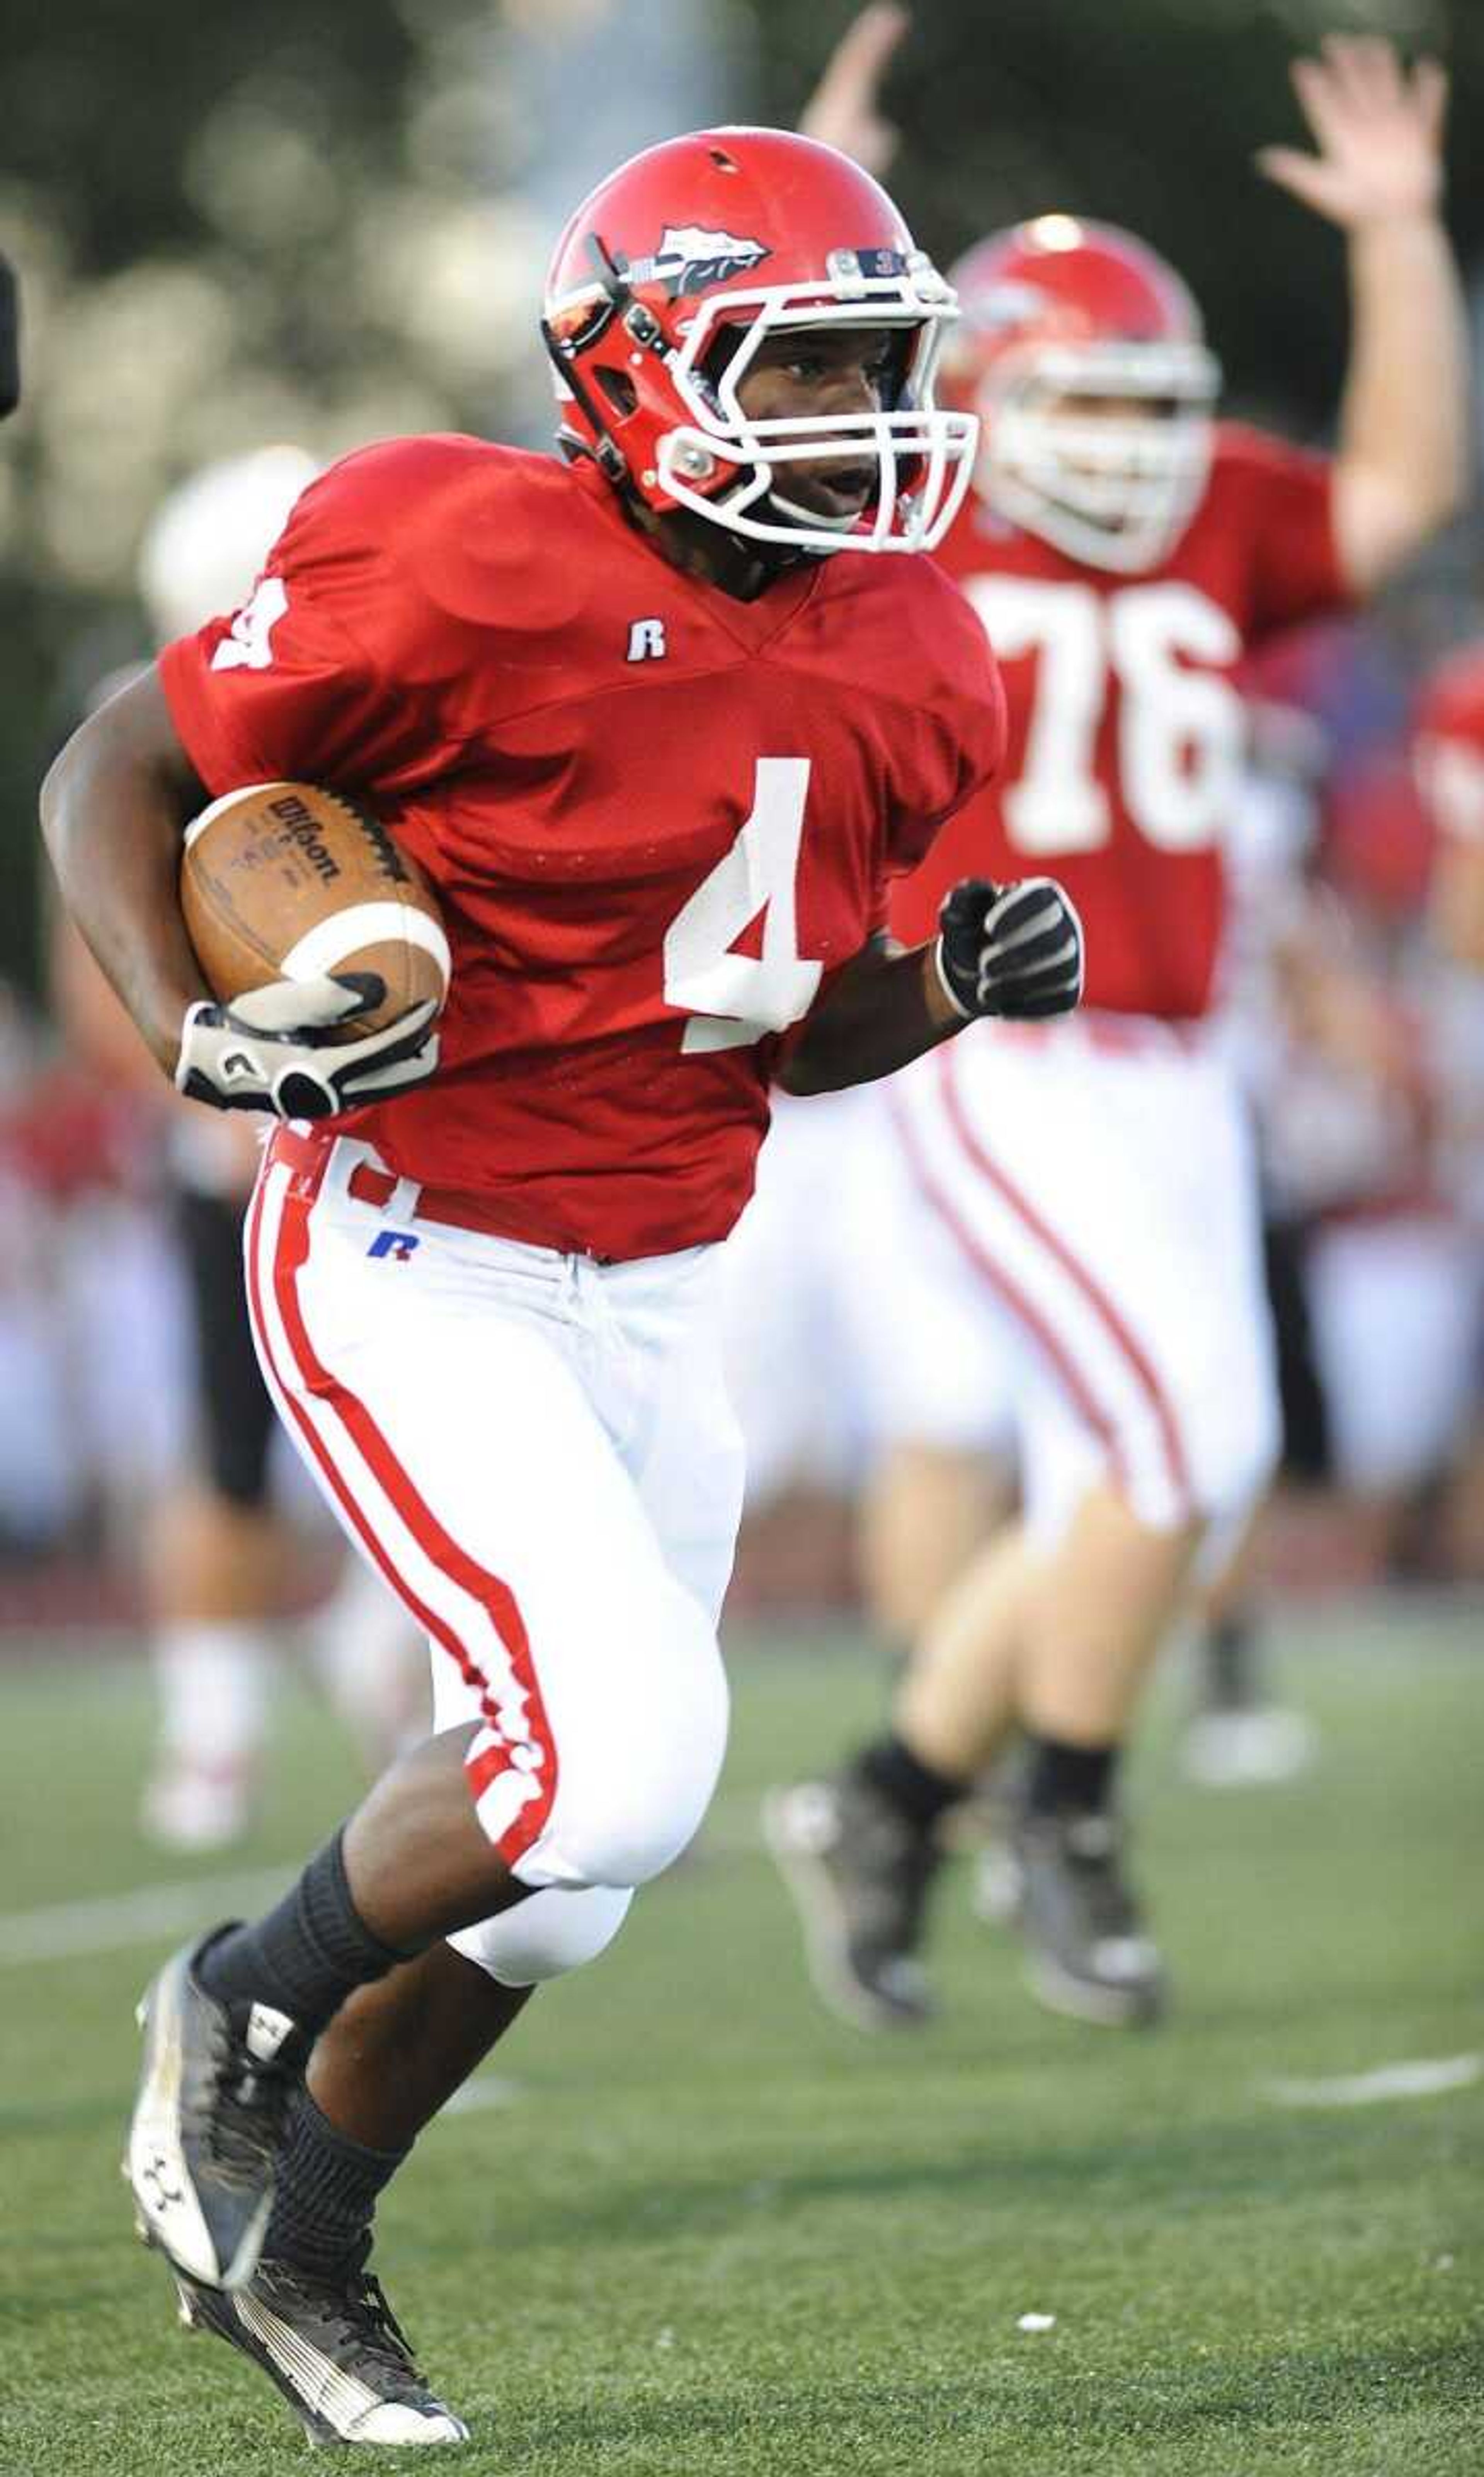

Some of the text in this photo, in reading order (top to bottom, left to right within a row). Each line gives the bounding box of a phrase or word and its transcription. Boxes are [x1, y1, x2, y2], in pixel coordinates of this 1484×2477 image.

[627, 618, 665, 662] R
[962, 572, 1244, 856] 76
[268, 795, 341, 887] Wilson
[663, 757, 824, 1054] 4
[366, 1231, 420, 1261] R
